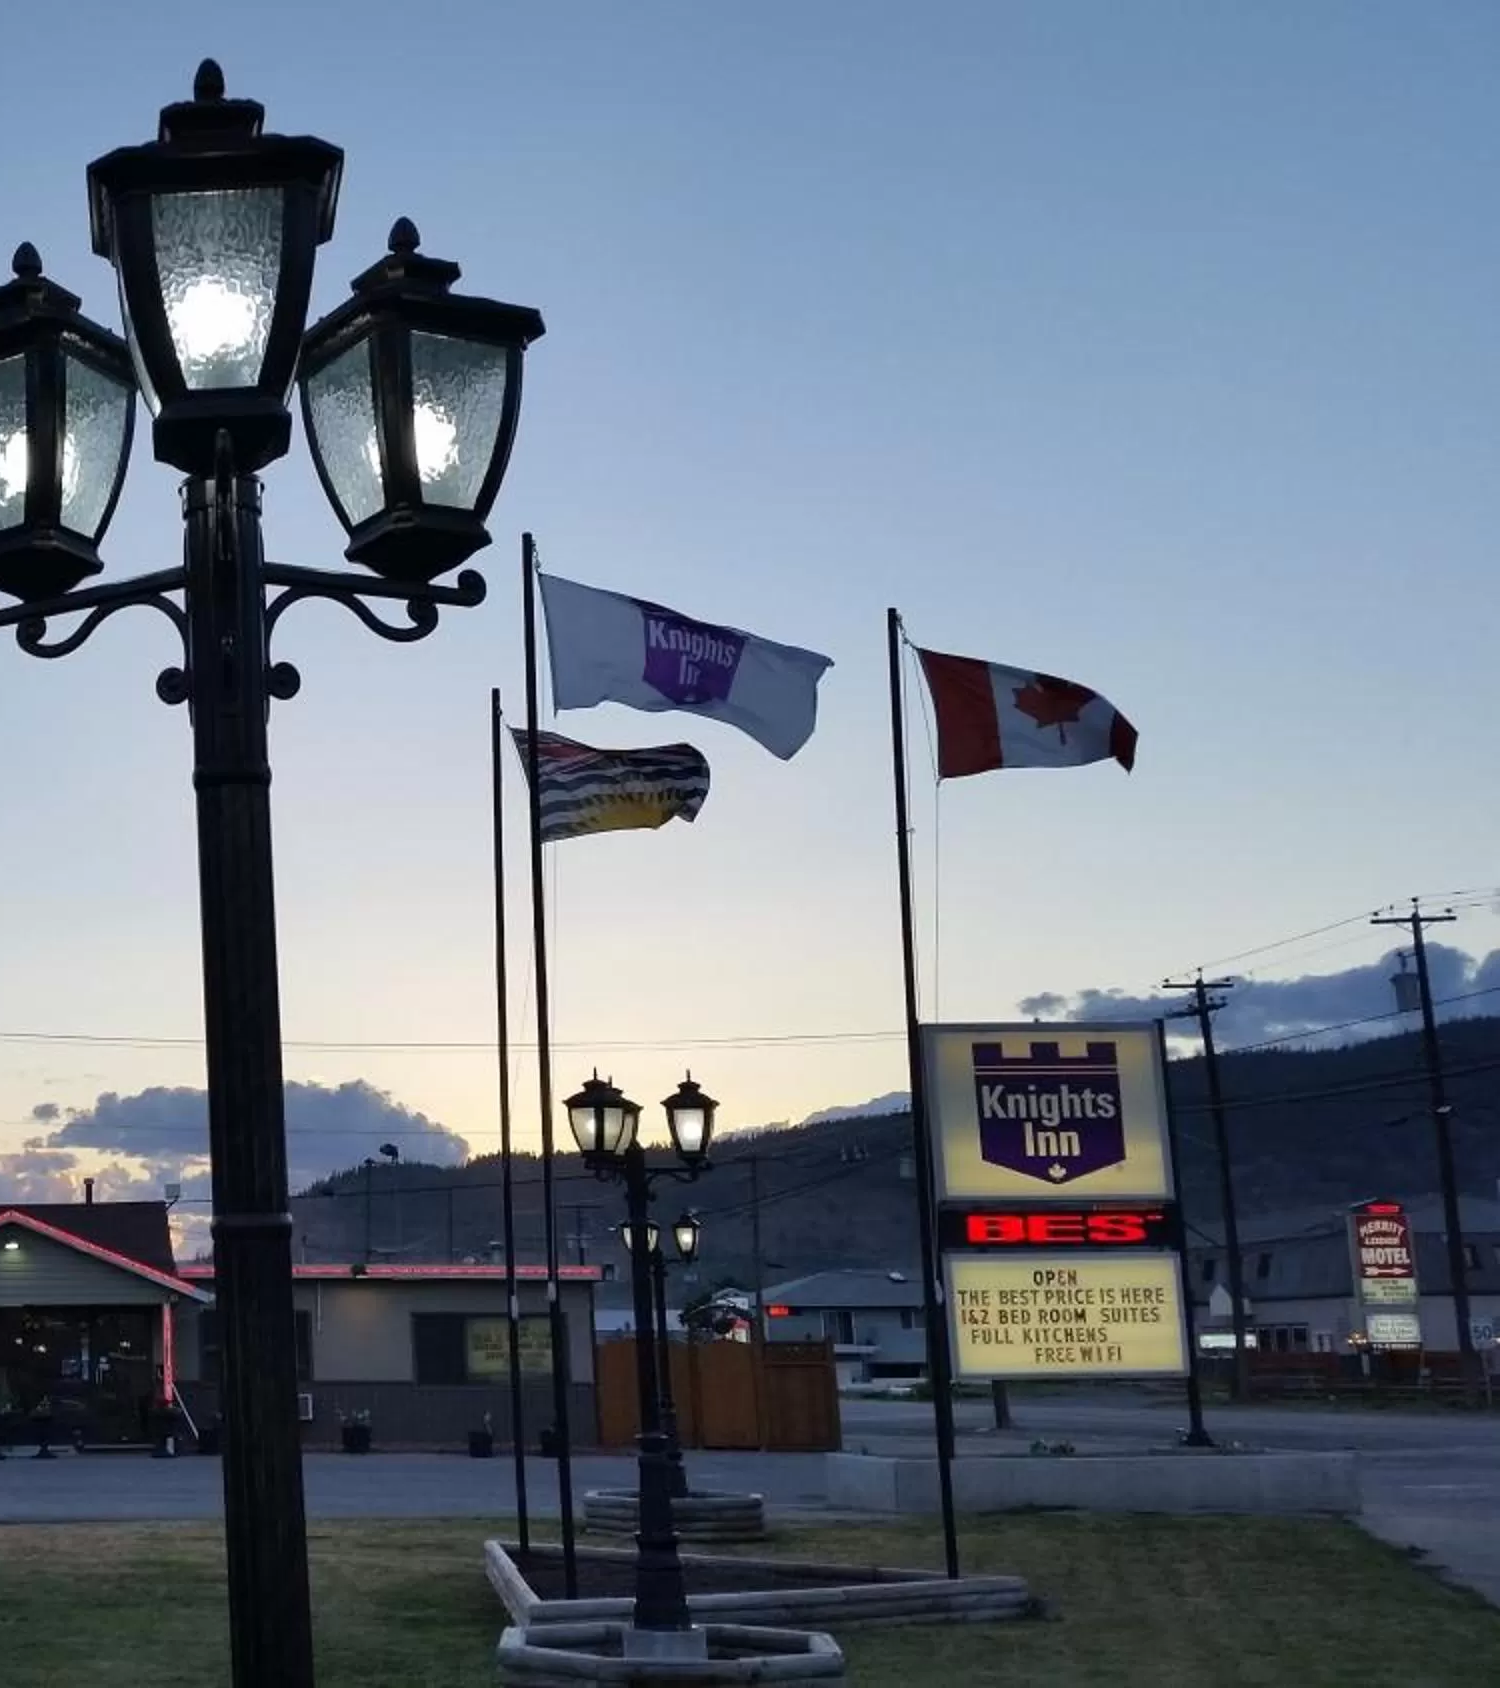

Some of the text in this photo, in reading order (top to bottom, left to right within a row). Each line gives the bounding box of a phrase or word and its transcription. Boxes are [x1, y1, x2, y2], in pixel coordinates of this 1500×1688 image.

[649, 619, 736, 669] Knights
[981, 1084, 1116, 1126] Knights
[1024, 1122, 1081, 1157] Inn
[966, 1213, 1163, 1243] BES
[1361, 1247, 1411, 1265] MOTEL
[1033, 1270, 1077, 1286] OPEN
[958, 1287, 1165, 1306] THE BEST PRICE IS HERE
[999, 1309, 1031, 1325] BED
[1039, 1308, 1087, 1324] ROOM
[1101, 1307, 1161, 1323] SUITES
[971, 1327, 1108, 1345] FULL KITCHENS
[1473, 1325, 1493, 1340] 50
[1035, 1347, 1075, 1364] FREE
